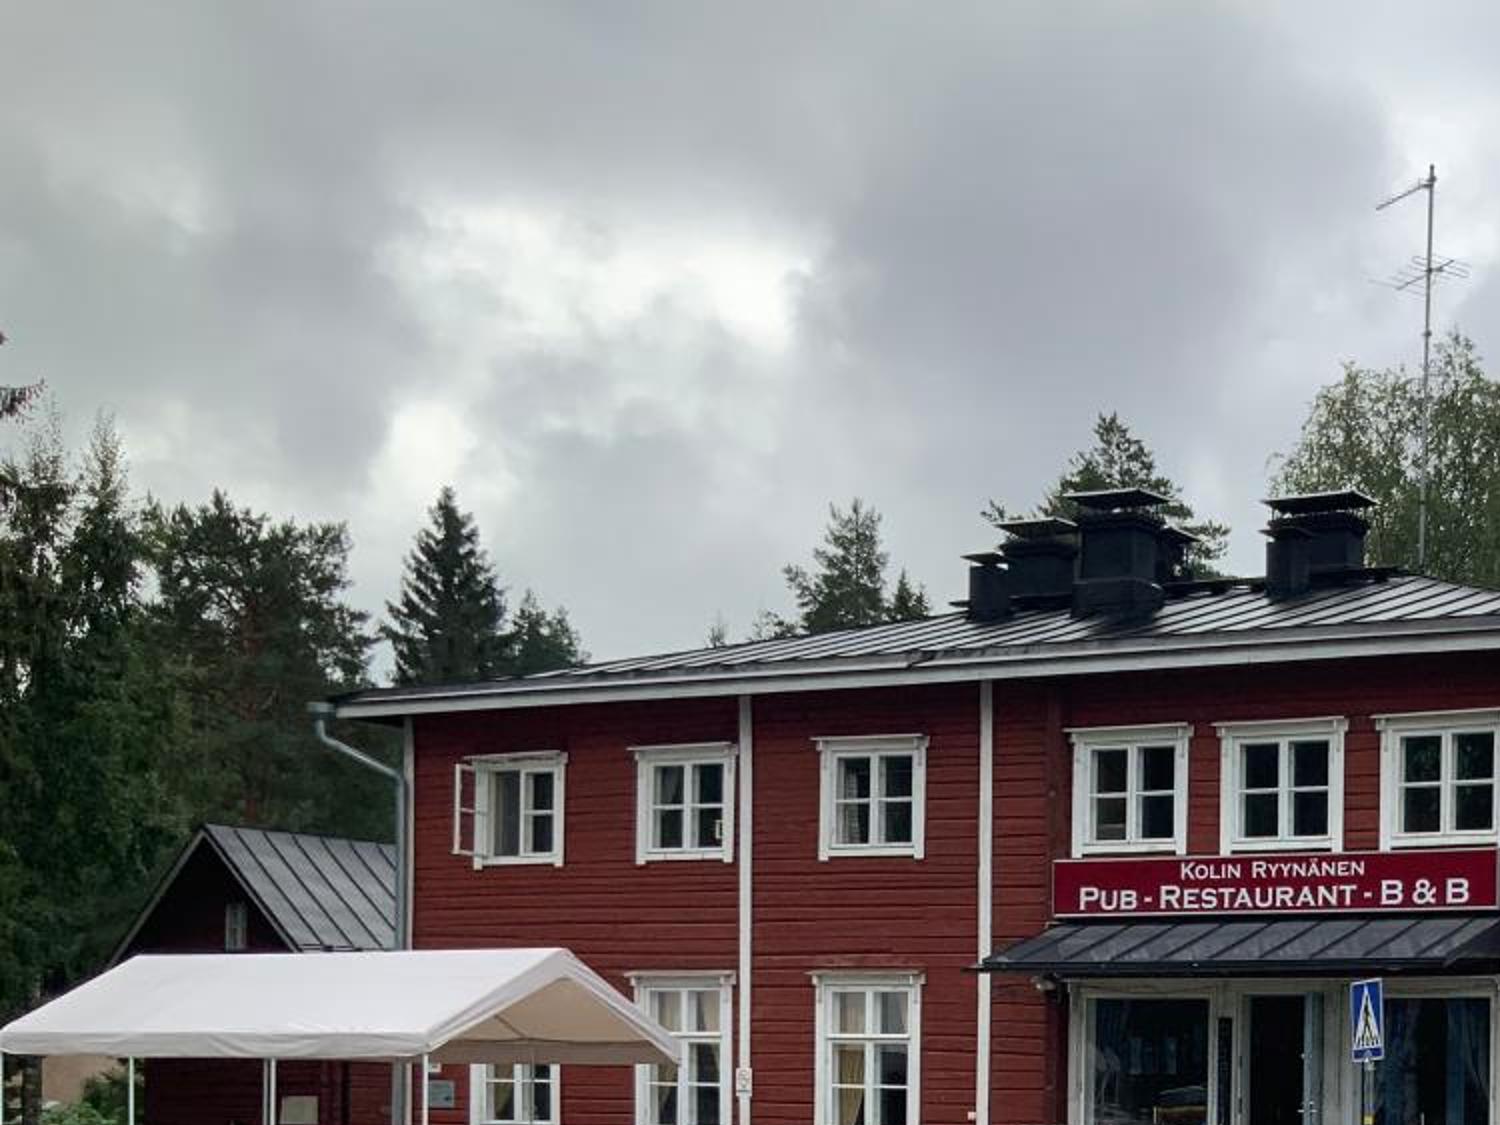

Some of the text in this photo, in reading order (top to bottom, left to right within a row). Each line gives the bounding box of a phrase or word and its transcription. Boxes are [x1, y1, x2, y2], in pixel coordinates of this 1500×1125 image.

[1181, 857, 1365, 881] KOLIN RYYNÄNEN
[1079, 887, 1137, 911] PUB
[1160, 885, 1357, 909] RESTAURANT
